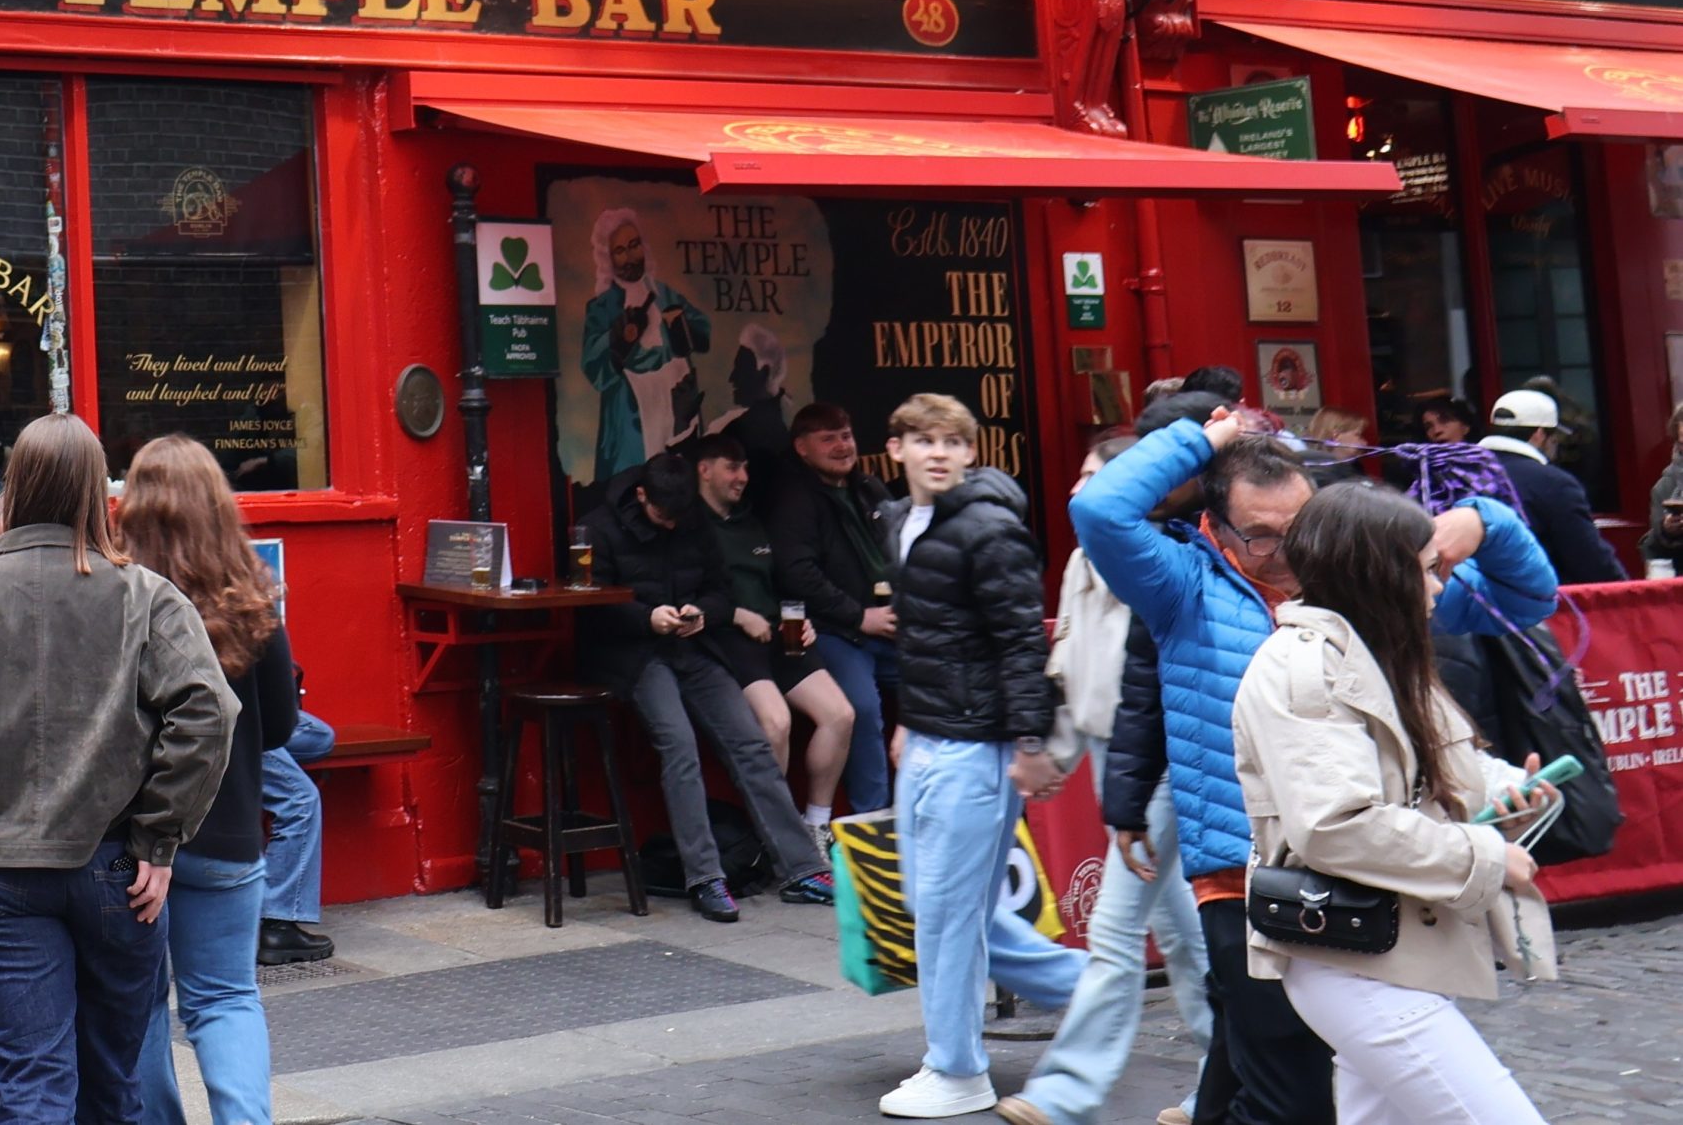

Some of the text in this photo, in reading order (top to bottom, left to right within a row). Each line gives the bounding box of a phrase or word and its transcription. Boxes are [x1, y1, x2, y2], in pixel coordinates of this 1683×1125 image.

[911, 0, 944, 33] 48
[708, 204, 778, 241] THE
[958, 215, 1009, 258] 1840
[675, 238, 812, 277] TEMPLE
[713, 277, 783, 316] BAR
[946, 270, 1009, 318] THE
[1276, 301, 1292, 313] 12
[489, 314, 511, 325] Teach
[512, 328, 527, 338] Pub
[874, 322, 1017, 370] EMPEROR
[173, 354, 212, 373] lived
[213, 354, 243, 373] and
[246, 354, 287, 373] loved
[126, 384, 156, 402] and
[159, 383, 220, 407] laughed
[222, 383, 252, 402] and
[980, 372, 1015, 420] OF
[229, 420, 294, 431] JAMES JOYCE
[215, 438, 276, 449] FINNEGAN'S
[1619, 671, 1670, 703] THE
[1590, 701, 1676, 745] MPLE
[1607, 752, 1646, 773] UBLIN
